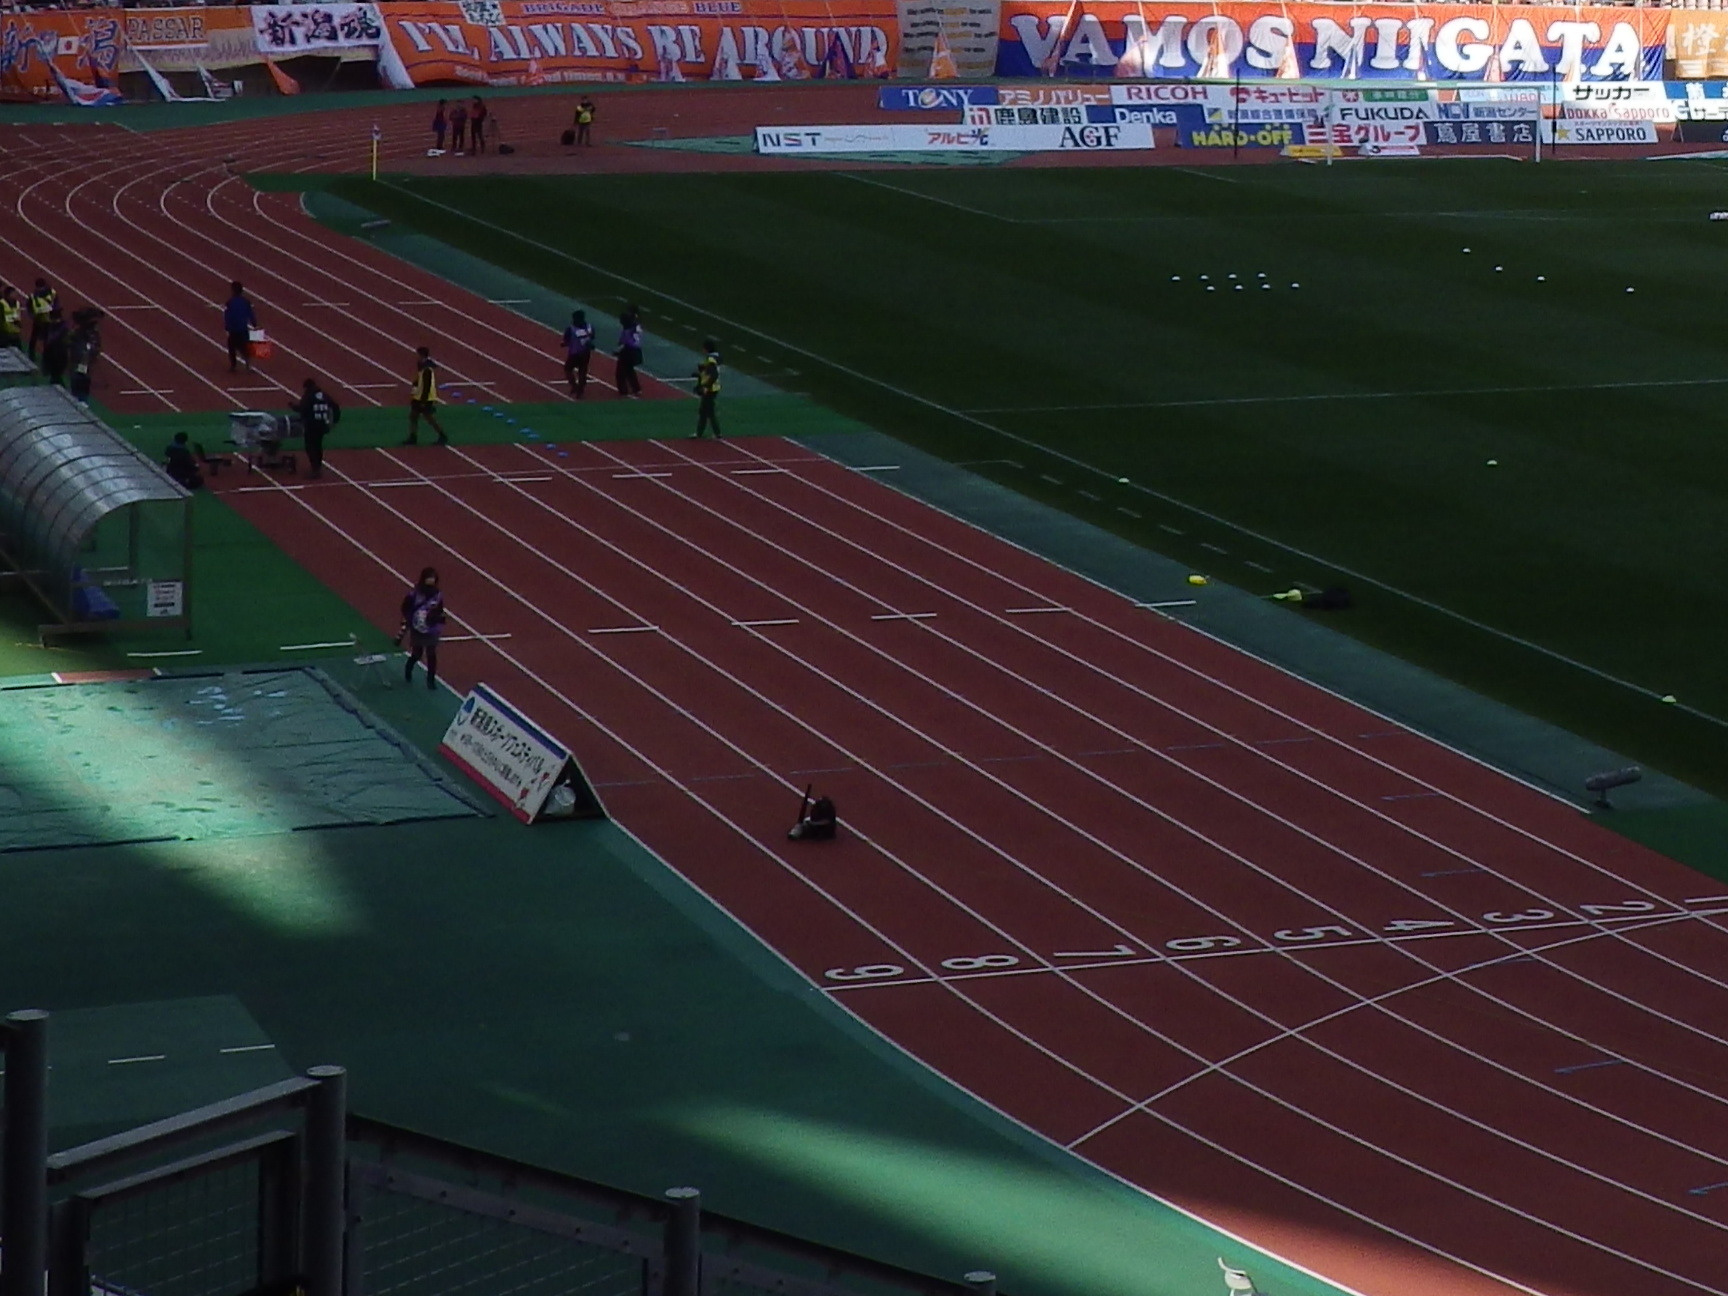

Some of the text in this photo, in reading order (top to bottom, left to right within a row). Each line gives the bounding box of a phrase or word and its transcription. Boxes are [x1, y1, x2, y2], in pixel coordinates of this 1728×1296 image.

[694, 2, 743, 14] BLUE
[489, 23, 644, 63] ALWAYS
[647, 24, 706, 64] BE
[716, 25, 889, 68] AROUND
[1010, 13, 1295, 70] VAMOS
[1309, 15, 1643, 78] NIIGATA
[902, 89, 974, 108] TONY
[998, 89, 1110, 106] アミノバリュー
[1126, 85, 1209, 102] RICOH
[994, 107, 1082, 125] 鹿島建設
[1115, 108, 1177, 124] Denka
[1340, 107, 1430, 121] FUKUDA
[1473, 106, 1538, 119] 新潟センター
[762, 132, 821, 148] NST
[1059, 125, 1122, 149] AGF
[1434, 122, 1533, 144] 蔦屋書店
[1575, 127, 1647, 142] SAPPORO
[825, 962, 906, 983] 9
[940, 953, 1019, 973] 8
[1054, 943, 1138, 962] 7
[1165, 935, 1242, 952] 6
[1275, 926, 1352, 944] 5
[1383, 916, 1455, 934] 4
[1481, 907, 1555, 925] 3
[1579, 898, 1655, 917] 2
